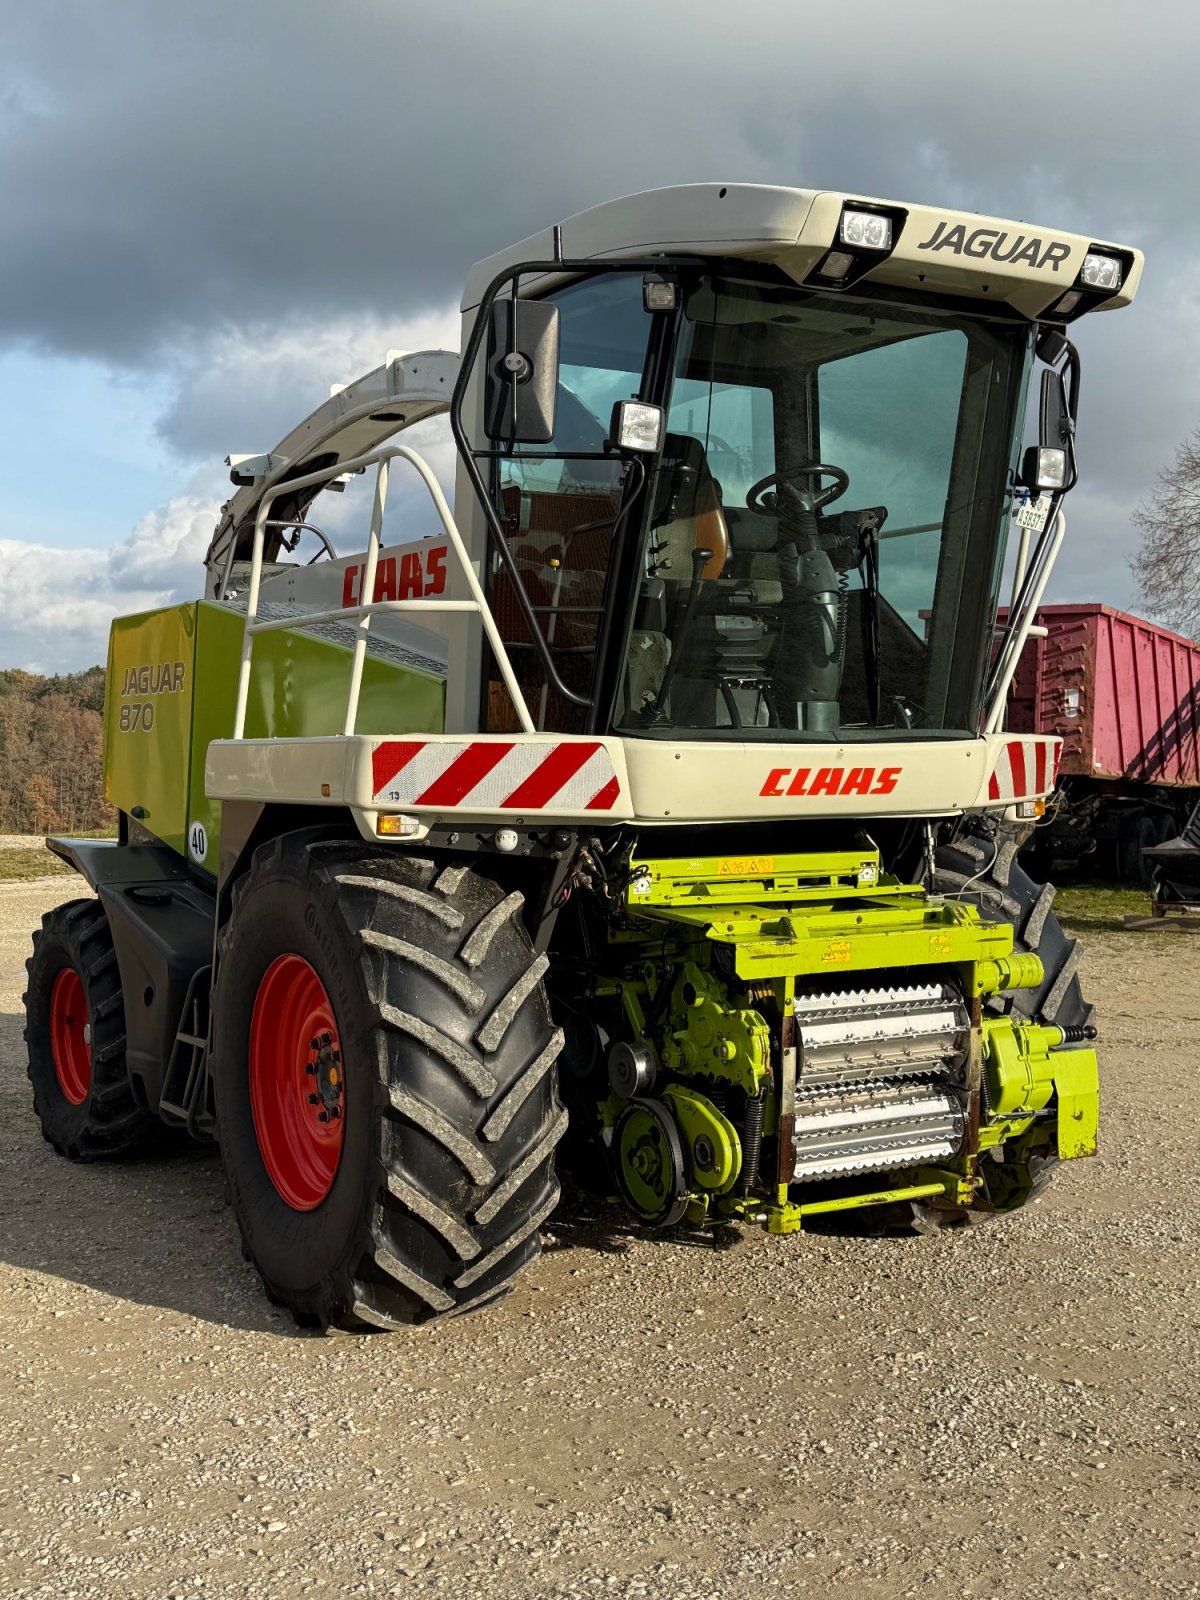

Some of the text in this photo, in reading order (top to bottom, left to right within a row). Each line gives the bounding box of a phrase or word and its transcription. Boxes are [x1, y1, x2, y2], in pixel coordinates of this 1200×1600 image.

[917, 221, 1071, 272] JAGUAR
[121, 661, 185, 697] JAGUAR
[119, 702, 154, 732] 870
[758, 767, 904, 797] CLAAS
[192, 827, 205, 855] 40
